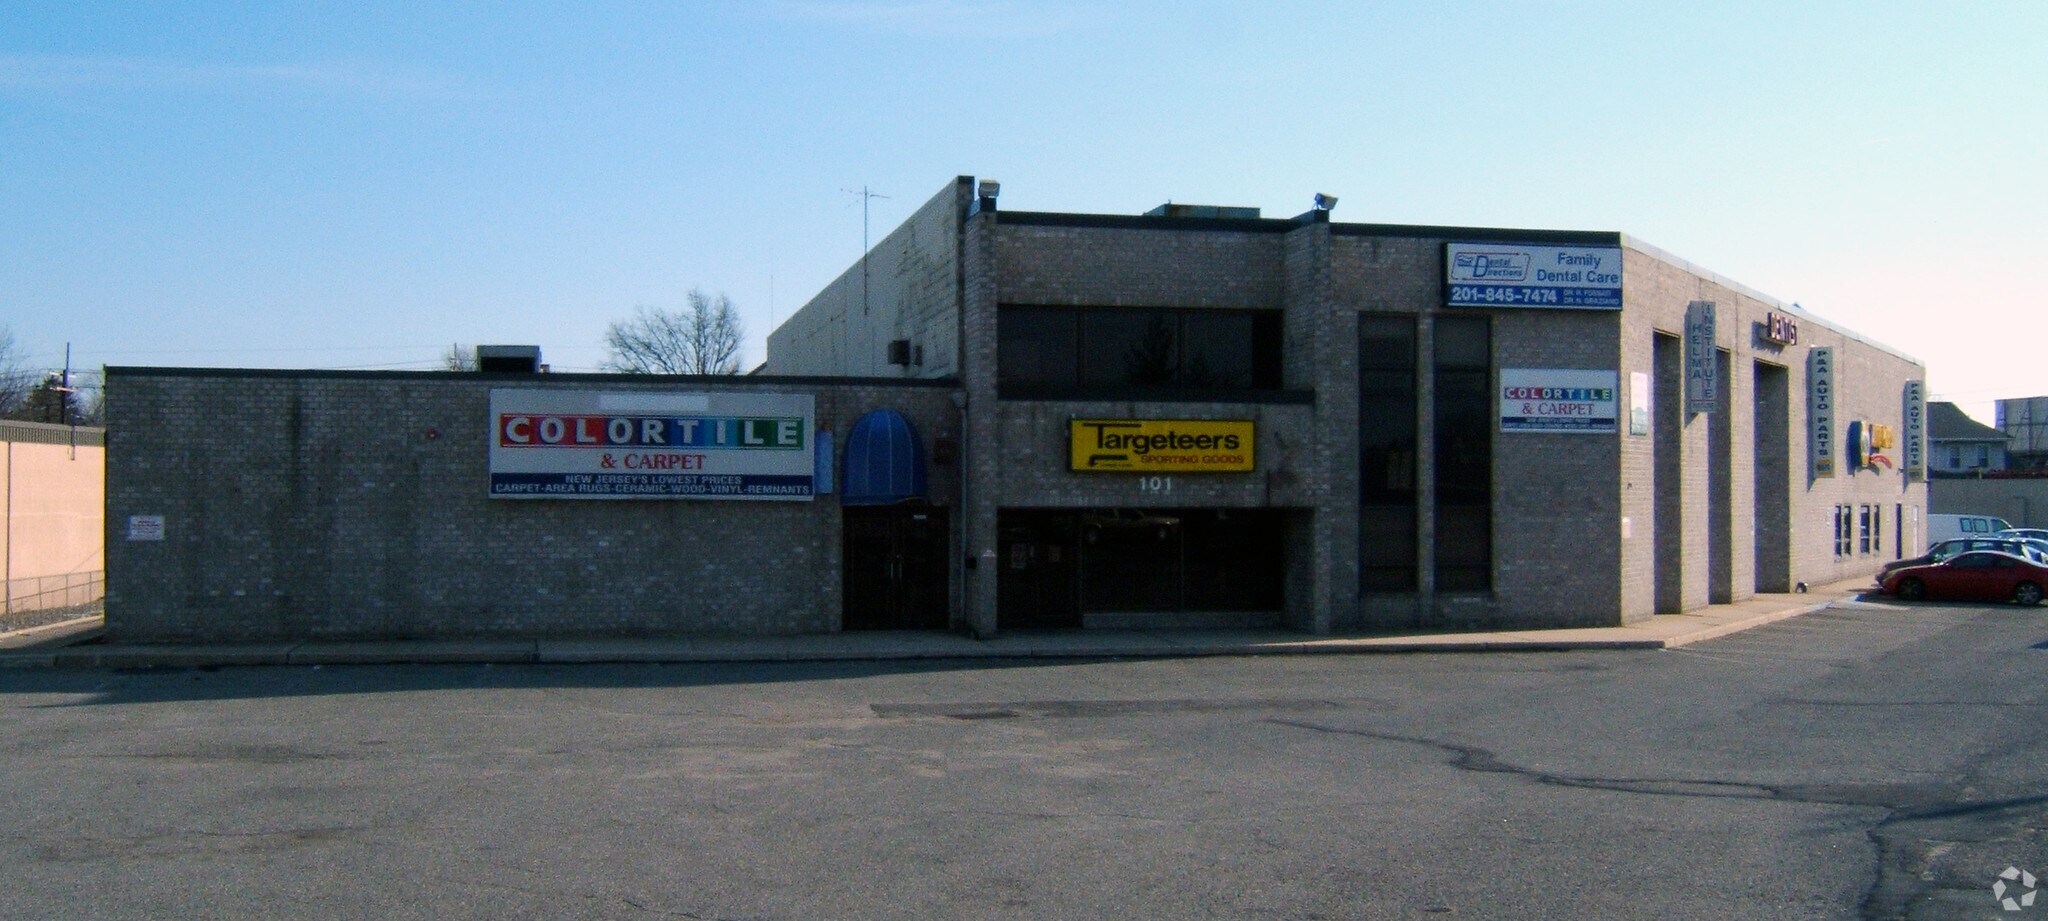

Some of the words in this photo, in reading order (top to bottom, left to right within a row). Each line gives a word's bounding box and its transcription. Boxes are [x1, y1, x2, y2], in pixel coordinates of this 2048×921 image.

[1557, 252, 1601, 270] Family
[1537, 269, 1581, 282] Dental
[1586, 270, 1619, 284] Care
[1452, 286, 1558, 303] 201-845-7474
[1692, 323, 1702, 378] HELMA
[1704, 304, 1713, 398] INSTITUTE
[1505, 388, 1611, 400] COLORTILE
[1817, 379, 1828, 410] AUTO
[1522, 402, 1533, 415] &
[1538, 403, 1595, 416] CARPET
[1910, 405, 1920, 430] AUTO
[505, 416, 799, 445] COLORTILE
[1083, 422, 1240, 454] Targeteers
[1817, 417, 1828, 456] PARTS
[600, 453, 617, 470] &
[624, 453, 708, 471] CARPET
[1140, 454, 1199, 464] SPORTING
[1202, 454, 1244, 464] GOODS
[565, 475, 592, 484] NEW
[596, 475, 648, 484] JERSEY'S
[652, 475, 699, 485] LOWEST
[701, 476, 742, 485] PRICES
[1139, 476, 1172, 491] 101
